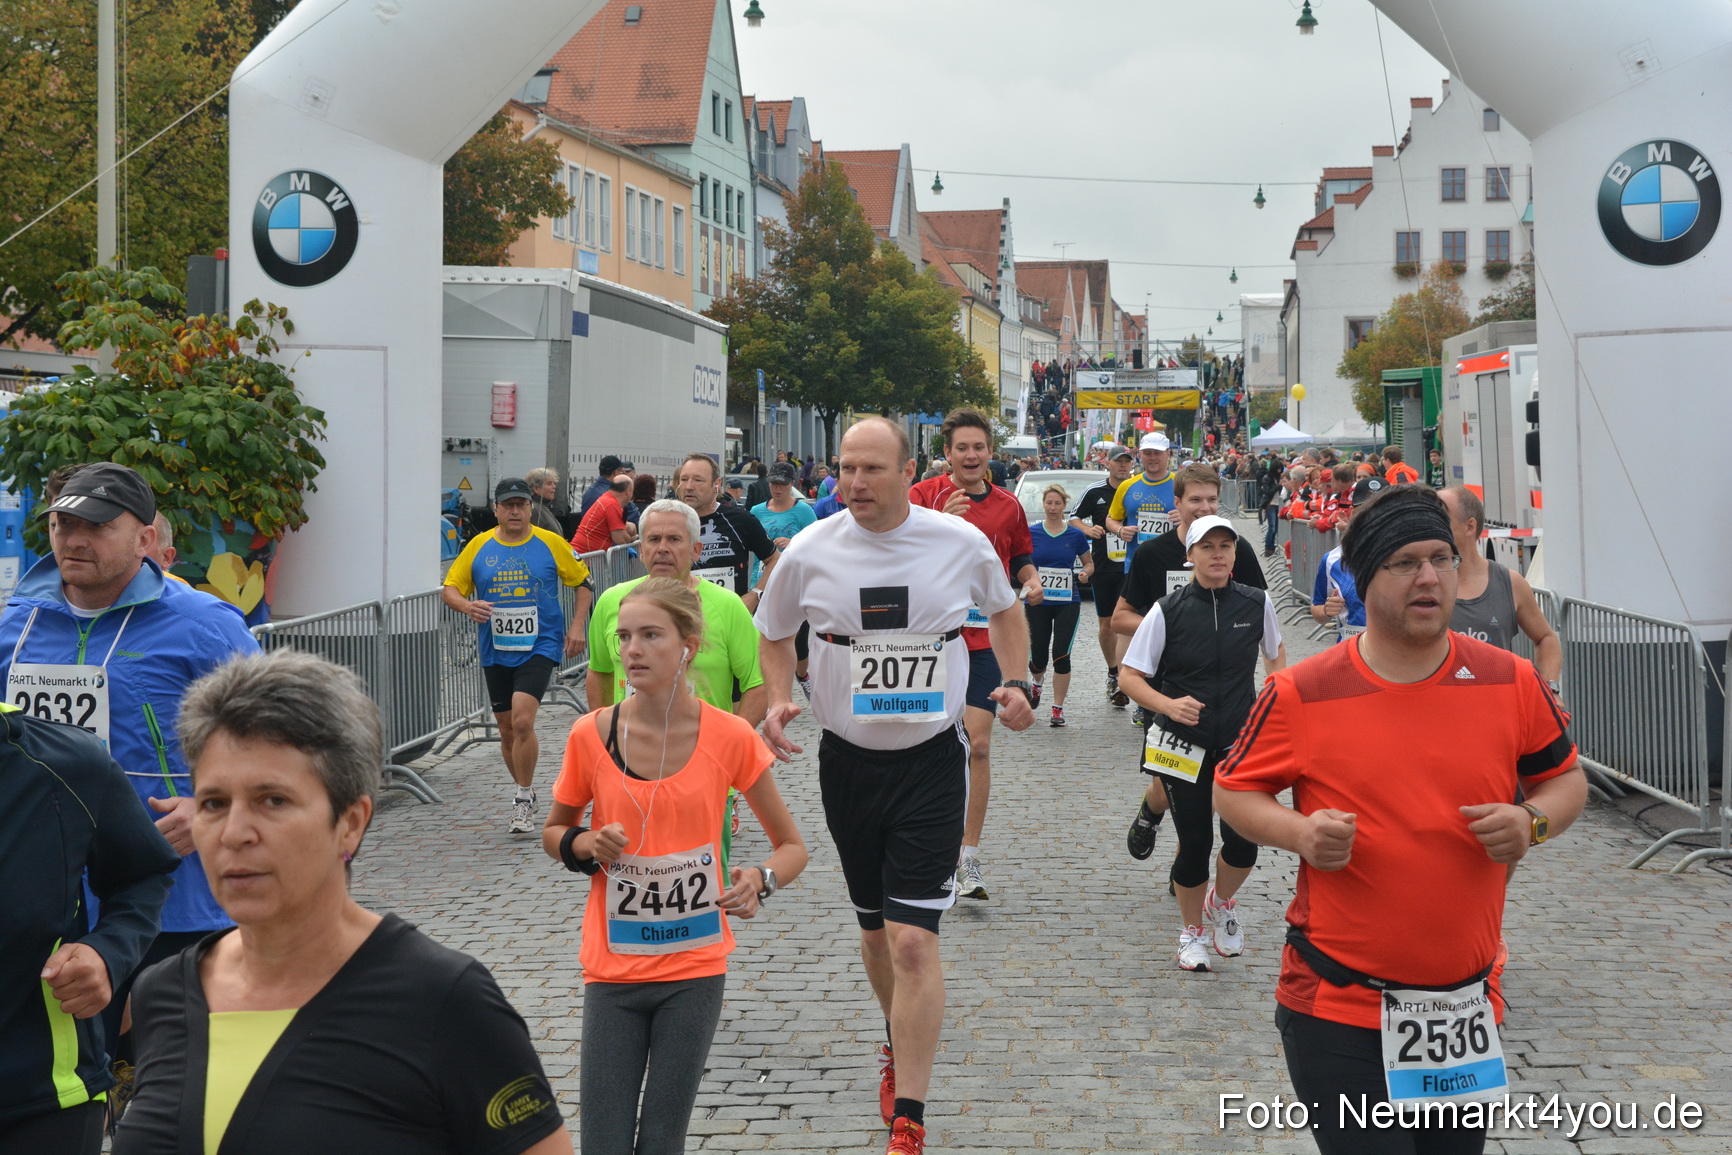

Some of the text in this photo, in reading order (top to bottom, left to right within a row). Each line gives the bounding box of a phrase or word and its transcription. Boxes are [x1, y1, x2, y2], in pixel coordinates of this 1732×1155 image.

[1606, 142, 1713, 186] BMW
[259, 172, 350, 211] BMW
[693, 364, 721, 407] BOCK
[1116, 394, 1159, 405] START
[1141, 520, 1170, 534] 2720
[1041, 575, 1069, 588] 2721
[495, 617, 535, 635] 3420
[852, 643, 931, 653] PARTL Neumarkt
[8, 675, 88, 687] PARTL Neumarkt
[861, 656, 938, 690] 2077
[15, 691, 97, 733] 2632
[870, 698, 929, 713] Wolfgang
[1154, 752, 1180, 768] Marga
[610, 859, 698, 876] PARTL Neumarkt
[617, 872, 710, 916] 2442
[641, 925, 690, 941] Chiara
[1385, 996, 1481, 1013] PARTL Neumarkt
[1397, 1010, 1490, 1063] 2536
[1422, 1072, 1478, 1092] Florian
